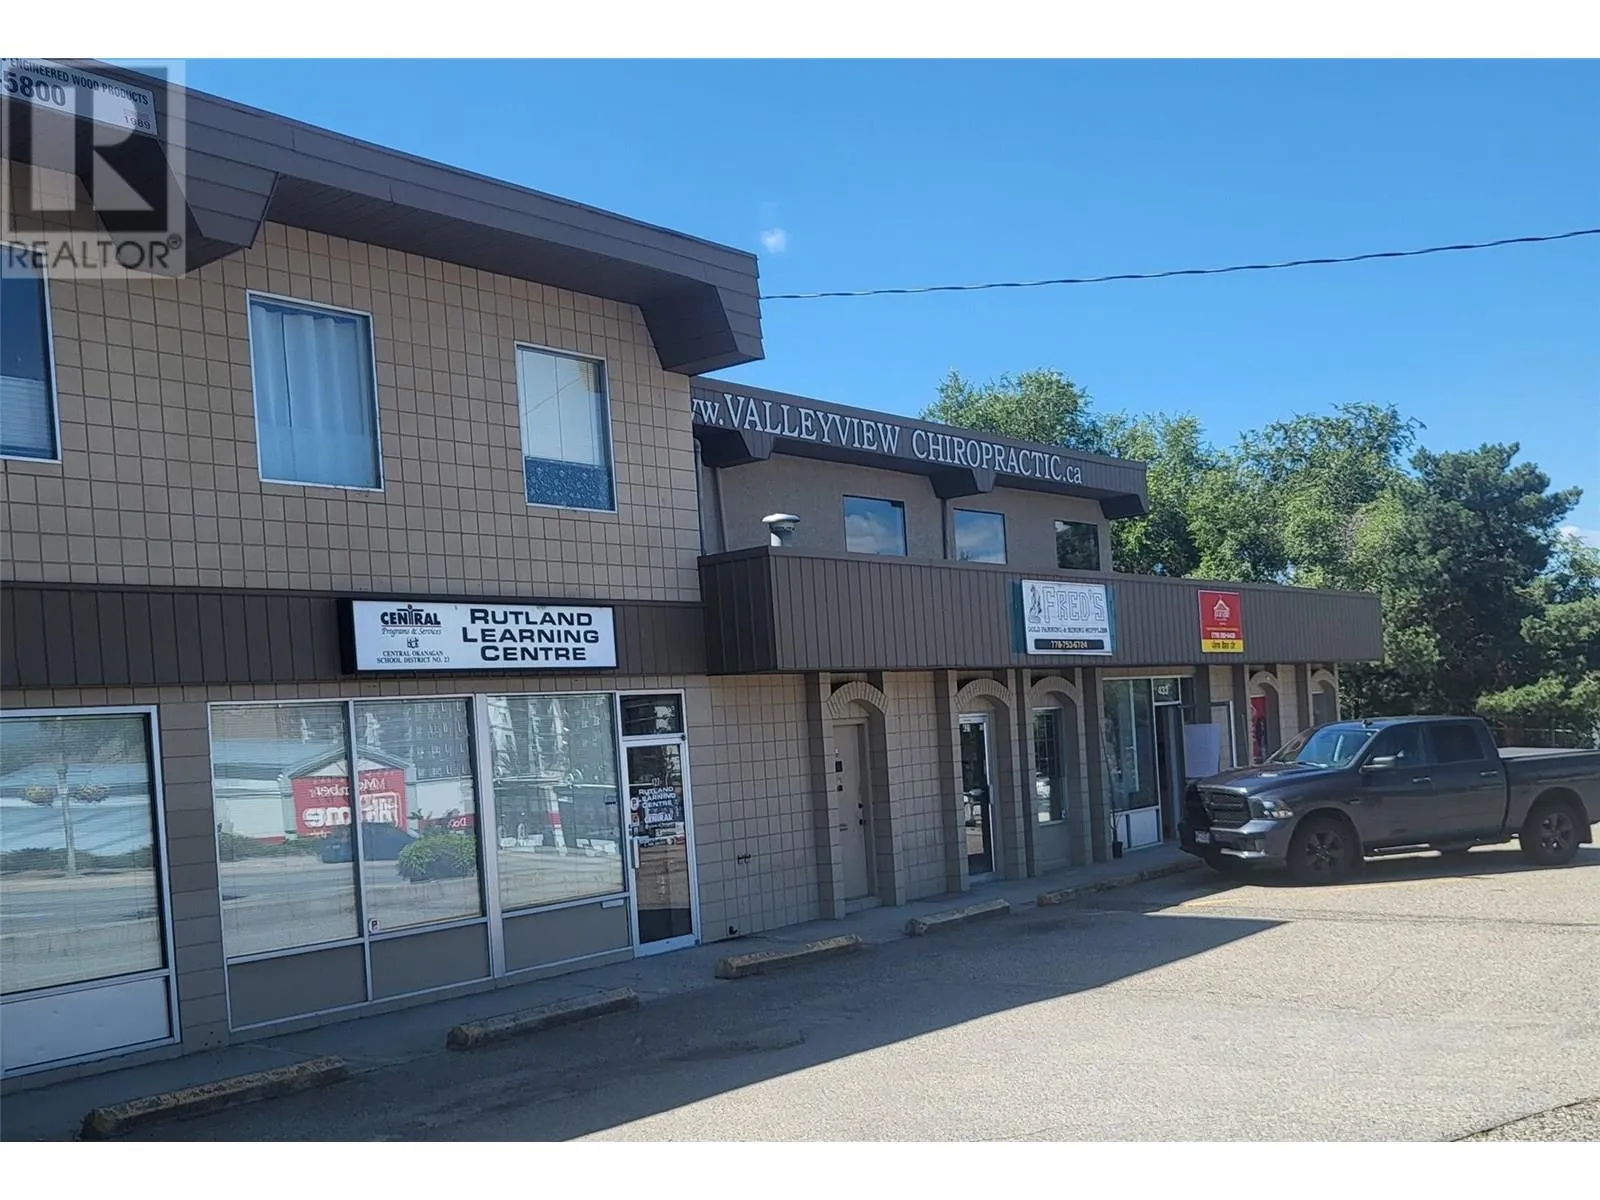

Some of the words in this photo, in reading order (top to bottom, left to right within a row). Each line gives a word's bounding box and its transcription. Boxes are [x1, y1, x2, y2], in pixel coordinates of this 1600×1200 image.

[0, 70, 66, 107] 5800
[11, 58, 69, 83] ENGINEERED
[72, 74, 99, 91] WOOD
[102, 82, 149, 106] PRODUCTS
[1042, 585, 1105, 623] FRED'S
[381, 605, 441, 626] CENTRAL
[470, 608, 593, 627] RUTLAND
[381, 627, 410, 638] Programs
[418, 627, 442, 636] Services
[462, 627, 600, 644] LEARNING
[376, 656, 402, 664] SCHOOL
[403, 656, 431, 664] DISTRICT
[412, 650, 444, 658] OKANAGAN
[481, 645, 587, 662] CENTRE
